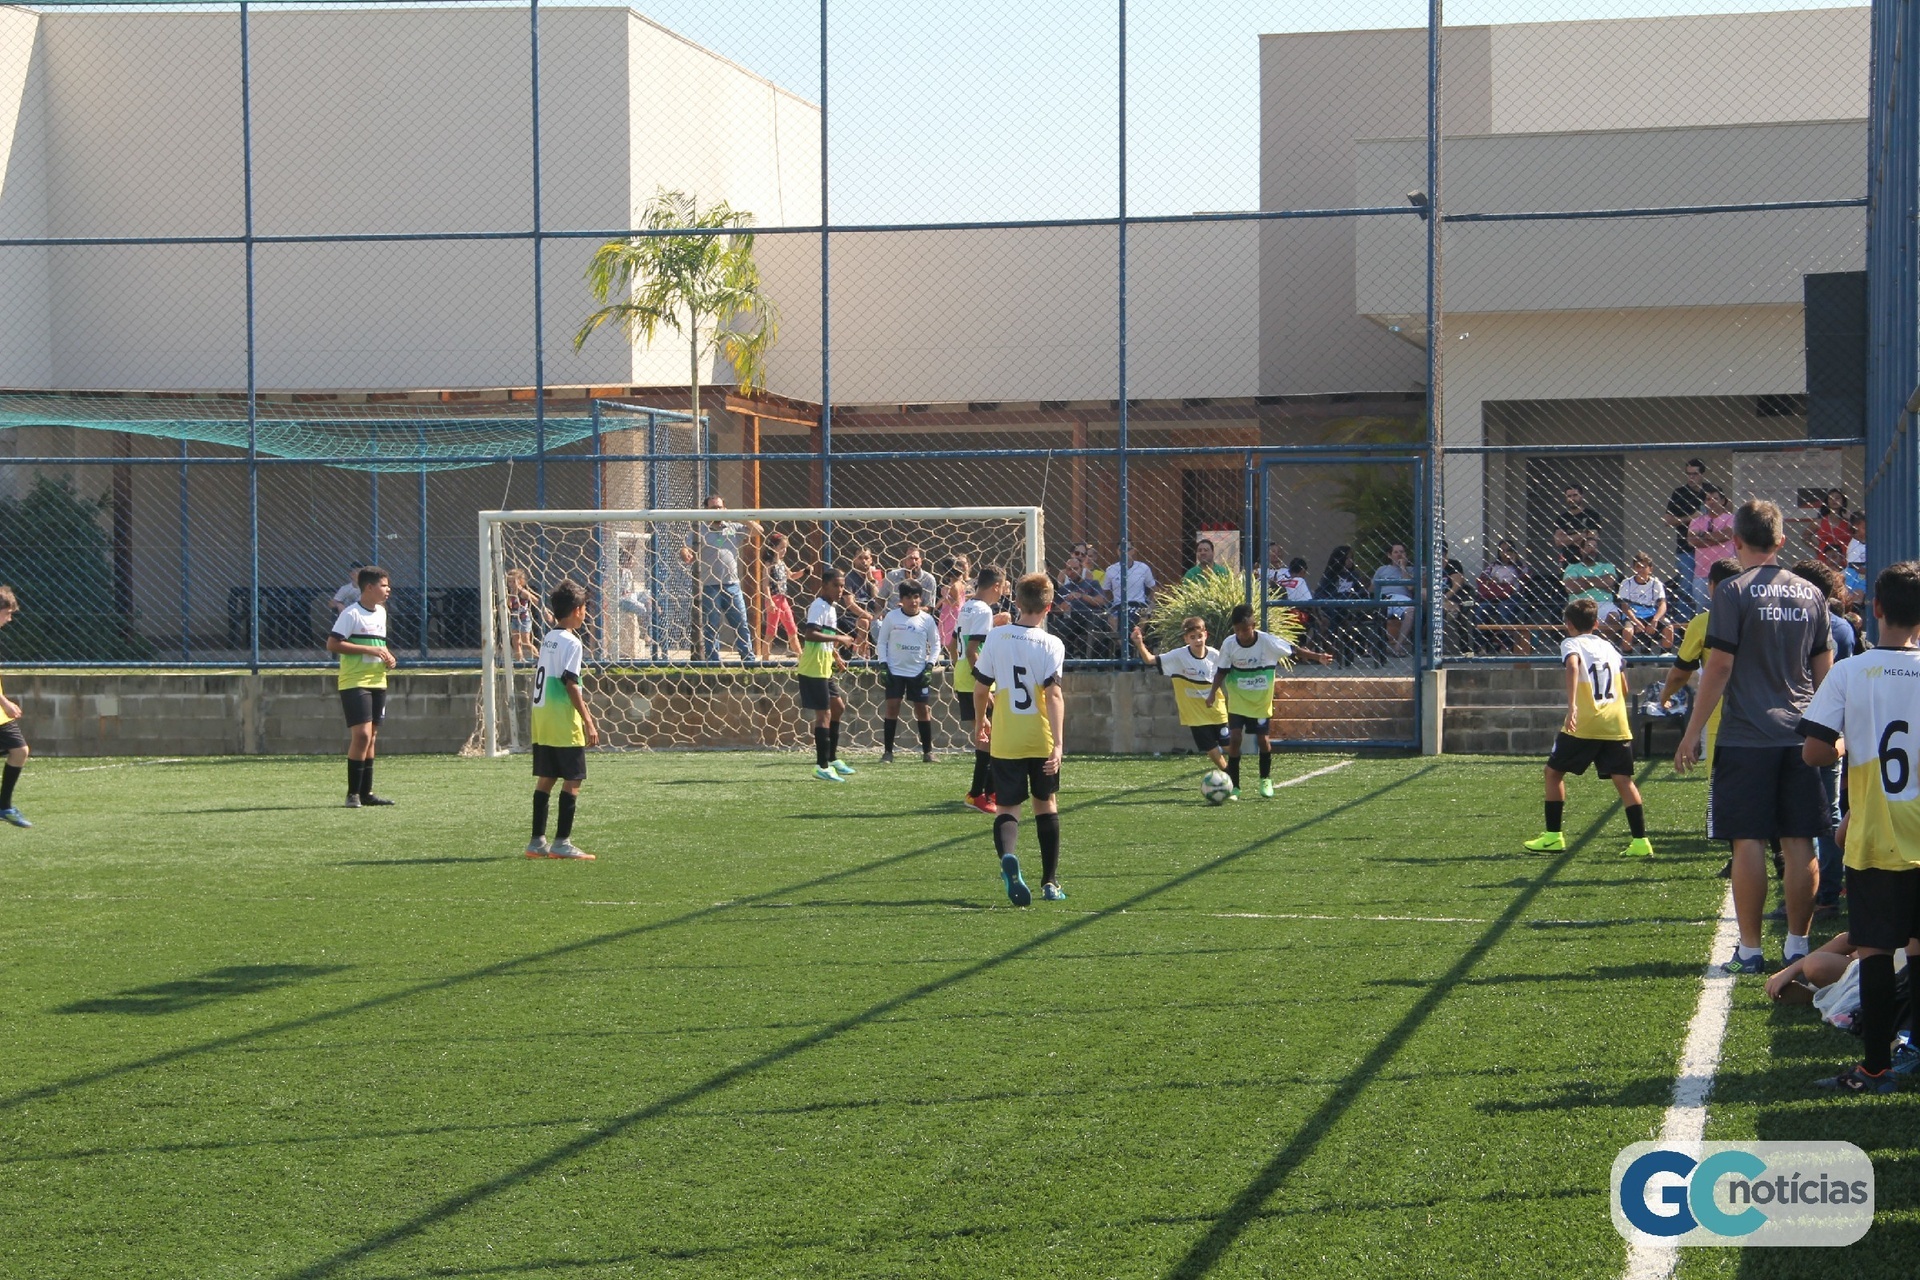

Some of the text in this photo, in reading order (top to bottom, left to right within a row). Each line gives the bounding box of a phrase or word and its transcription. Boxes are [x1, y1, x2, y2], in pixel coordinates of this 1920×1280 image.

[1750, 583, 1813, 600] COMISSÃO
[1758, 603, 1809, 622] TÉCNICA
[534, 666, 546, 704] 9
[1013, 665, 1033, 710] 5
[1588, 662, 1614, 700] 12
[1884, 668, 1920, 678] MEGAM
[1878, 720, 1910, 794] 6
